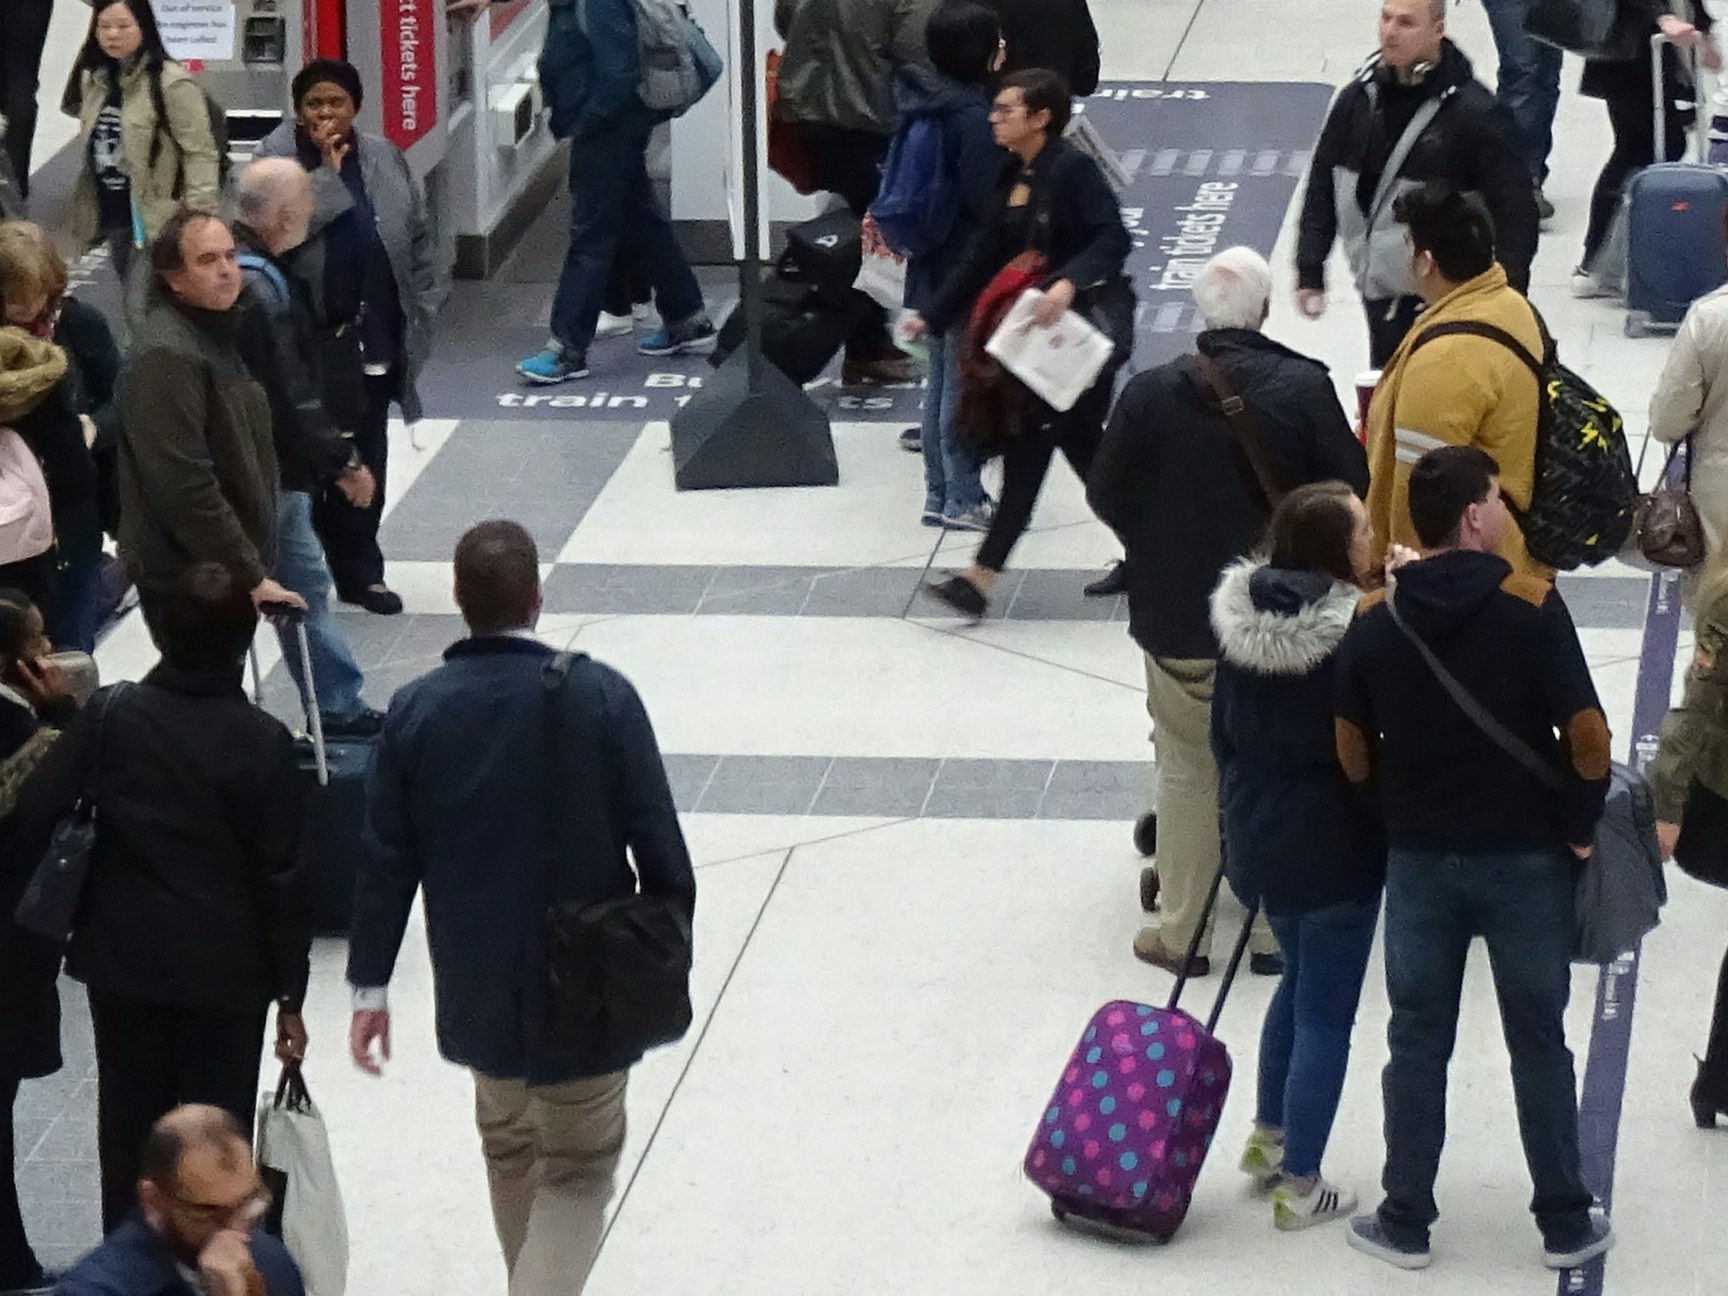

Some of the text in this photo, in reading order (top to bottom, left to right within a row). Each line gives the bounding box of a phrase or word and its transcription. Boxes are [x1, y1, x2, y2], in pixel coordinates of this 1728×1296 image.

[398, 15, 420, 81] tickets
[400, 85, 422, 130] here
[495, 390, 648, 410] train
